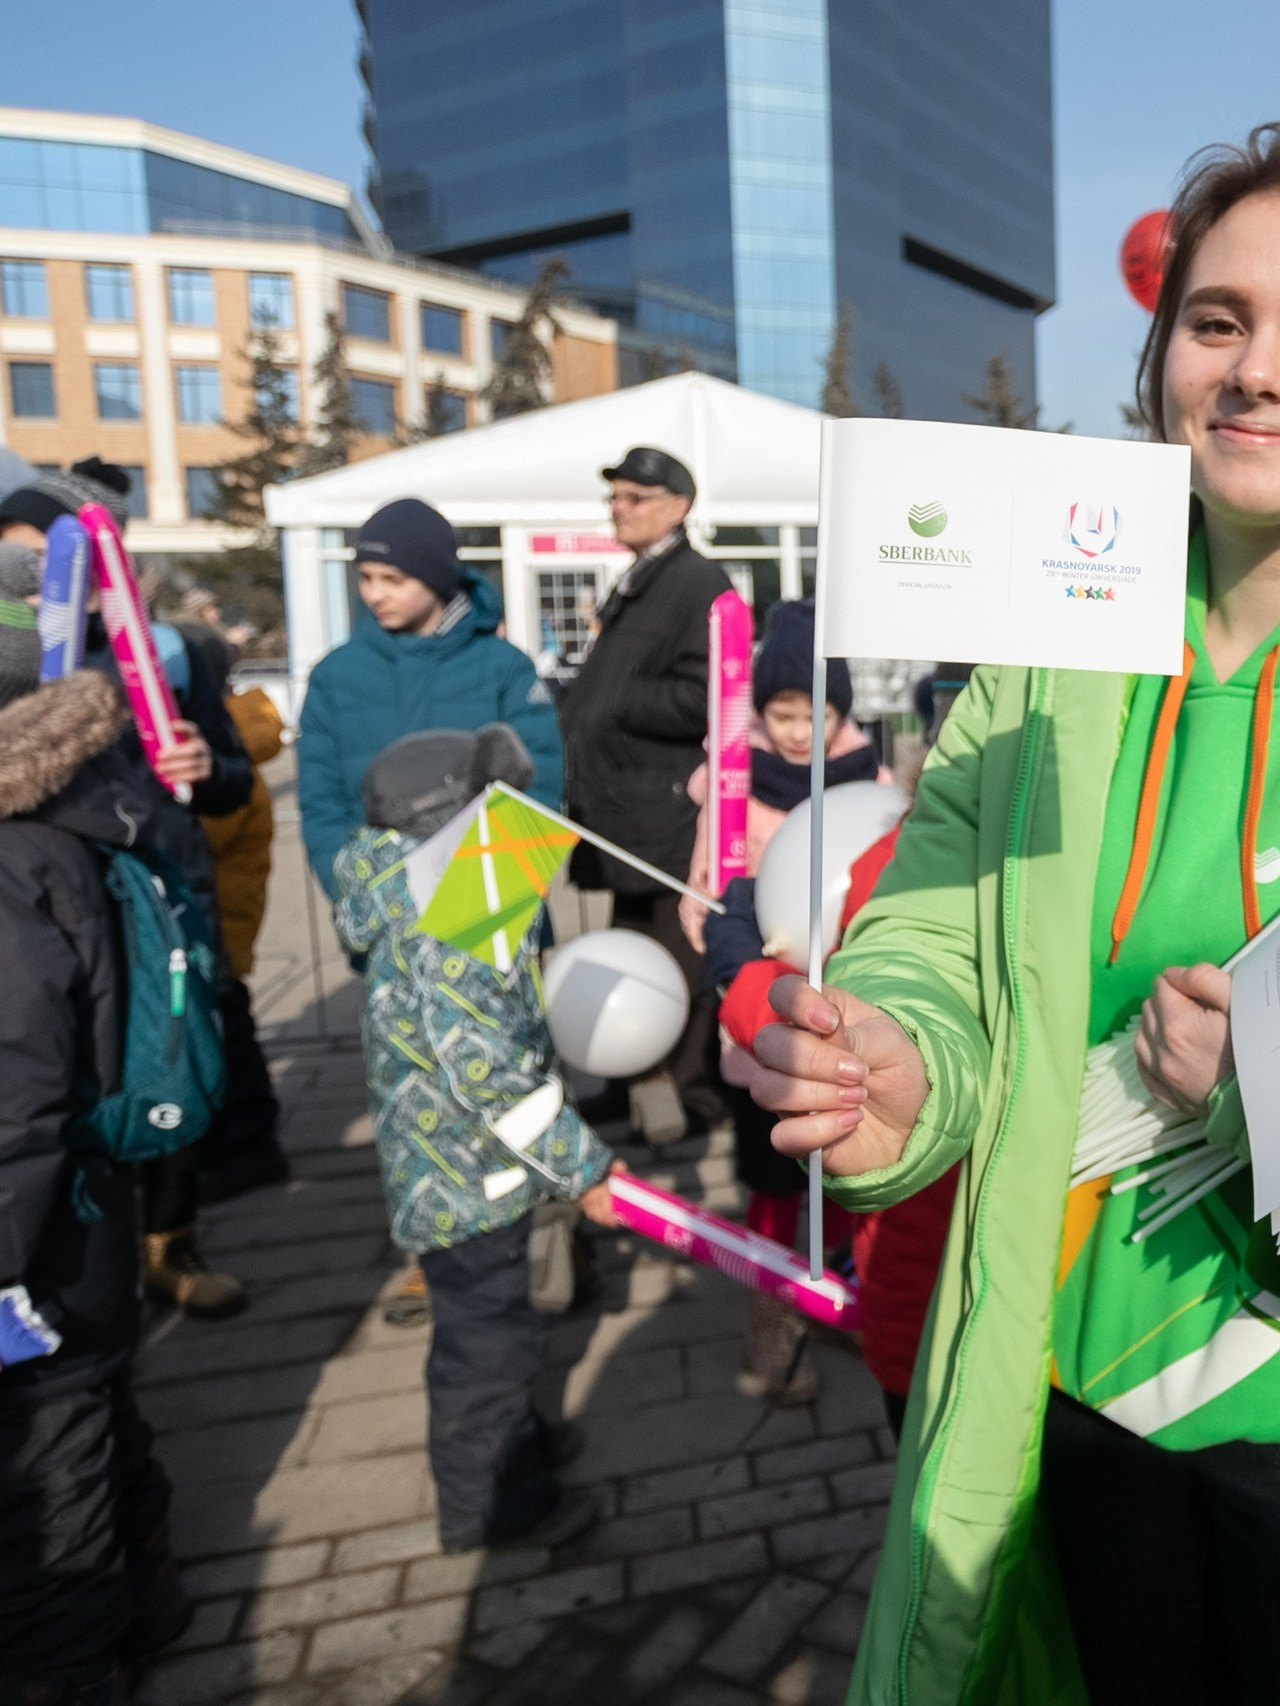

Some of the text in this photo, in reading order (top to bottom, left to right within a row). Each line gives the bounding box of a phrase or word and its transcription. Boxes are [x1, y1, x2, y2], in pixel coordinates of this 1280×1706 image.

[879, 545, 972, 564] SBERBANK
[1042, 559, 1141, 575] KRASNOYARSK 2019
[1062, 571, 1089, 580] WINTER
[1090, 573, 1136, 583] UNIVERSIADE
